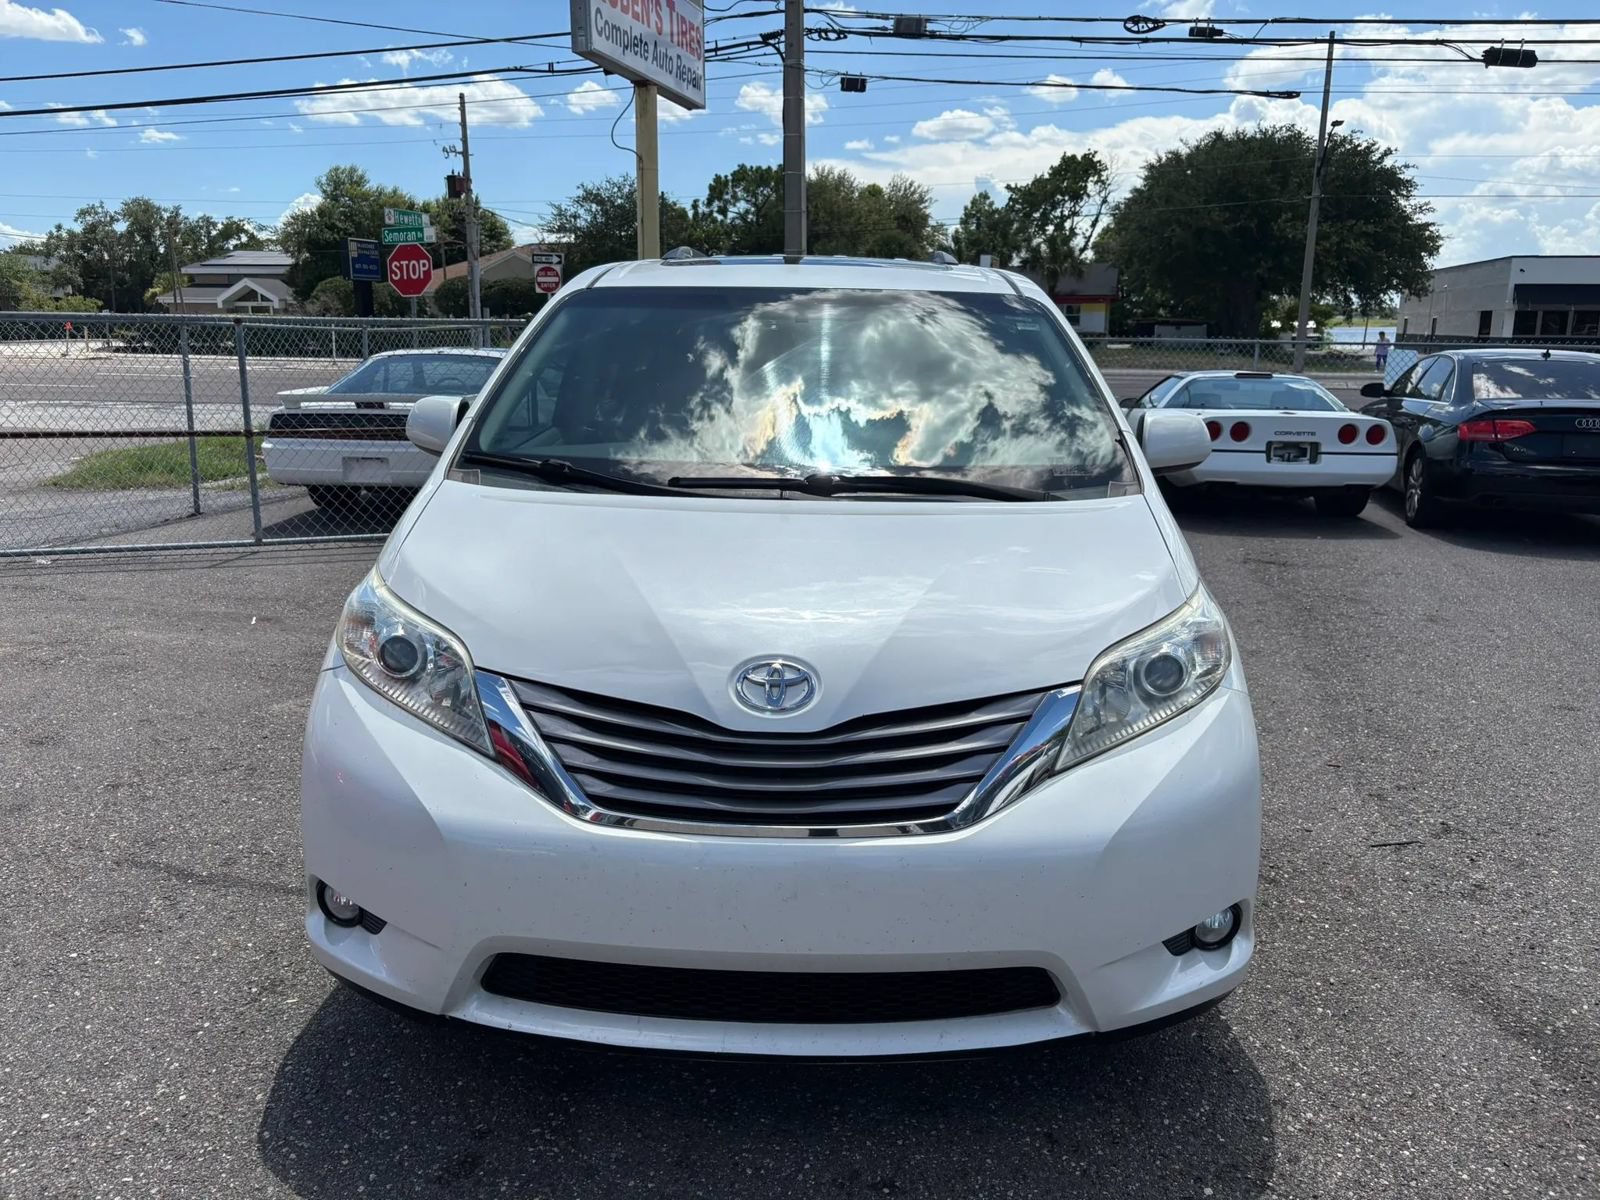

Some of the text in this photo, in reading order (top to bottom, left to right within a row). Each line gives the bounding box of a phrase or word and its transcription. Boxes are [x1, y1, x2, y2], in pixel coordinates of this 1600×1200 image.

[594, 7, 703, 92] Complete Auto Repair
[666, 0, 701, 60] TIRES
[384, 230, 417, 242] Semoran
[391, 260, 429, 280] STOP
